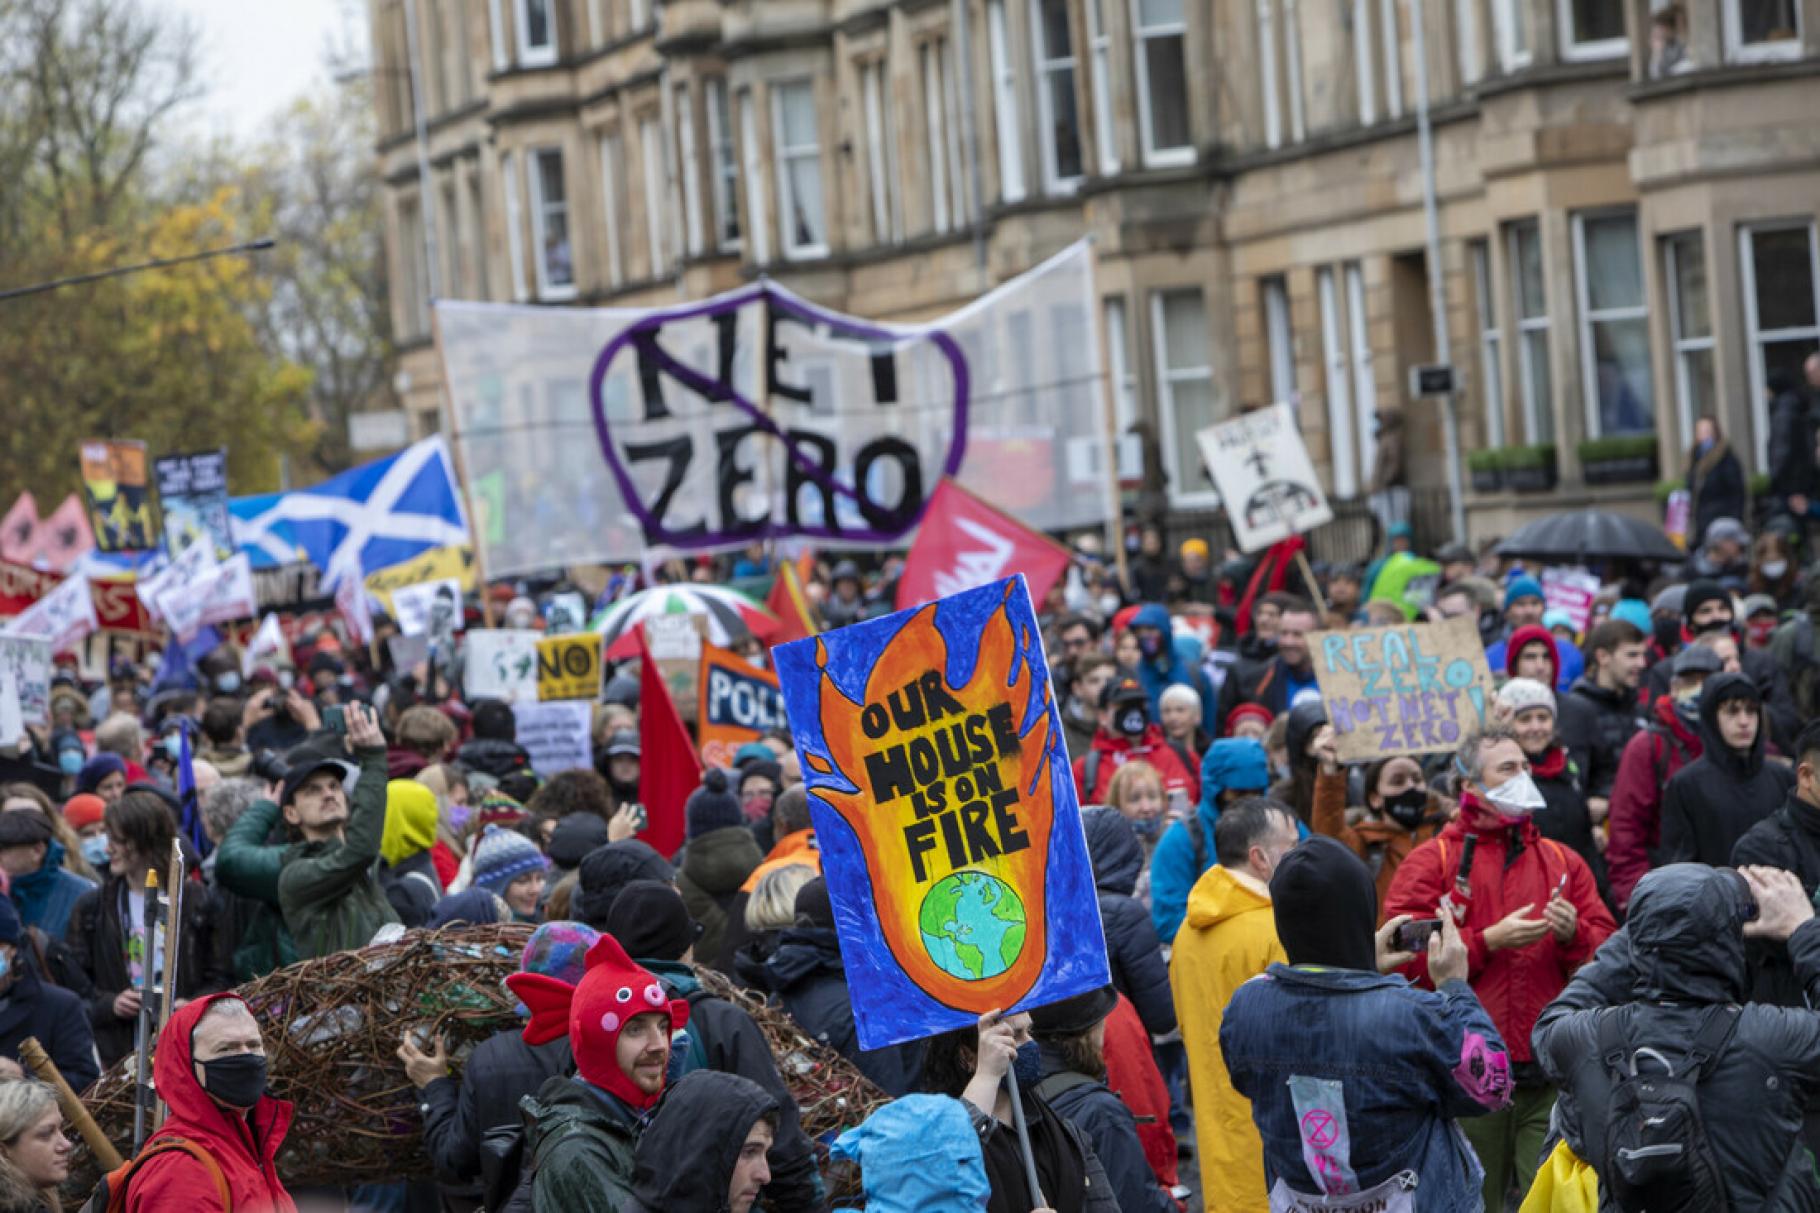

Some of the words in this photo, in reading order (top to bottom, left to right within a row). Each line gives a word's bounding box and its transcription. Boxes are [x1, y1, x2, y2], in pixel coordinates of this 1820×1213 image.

[632, 302, 898, 422] NET
[624, 426, 922, 547] ZERO
[1323, 627, 1440, 674] REAL
[861, 669, 966, 740] OUR
[1330, 696, 1391, 736] NOT
[1399, 690, 1460, 722] NET
[1375, 719, 1460, 751] ZERO
[863, 702, 1024, 804] HOUSE
[914, 780, 948, 820] IS
[959, 761, 1005, 800] ON
[903, 787, 1031, 884] FIRE
